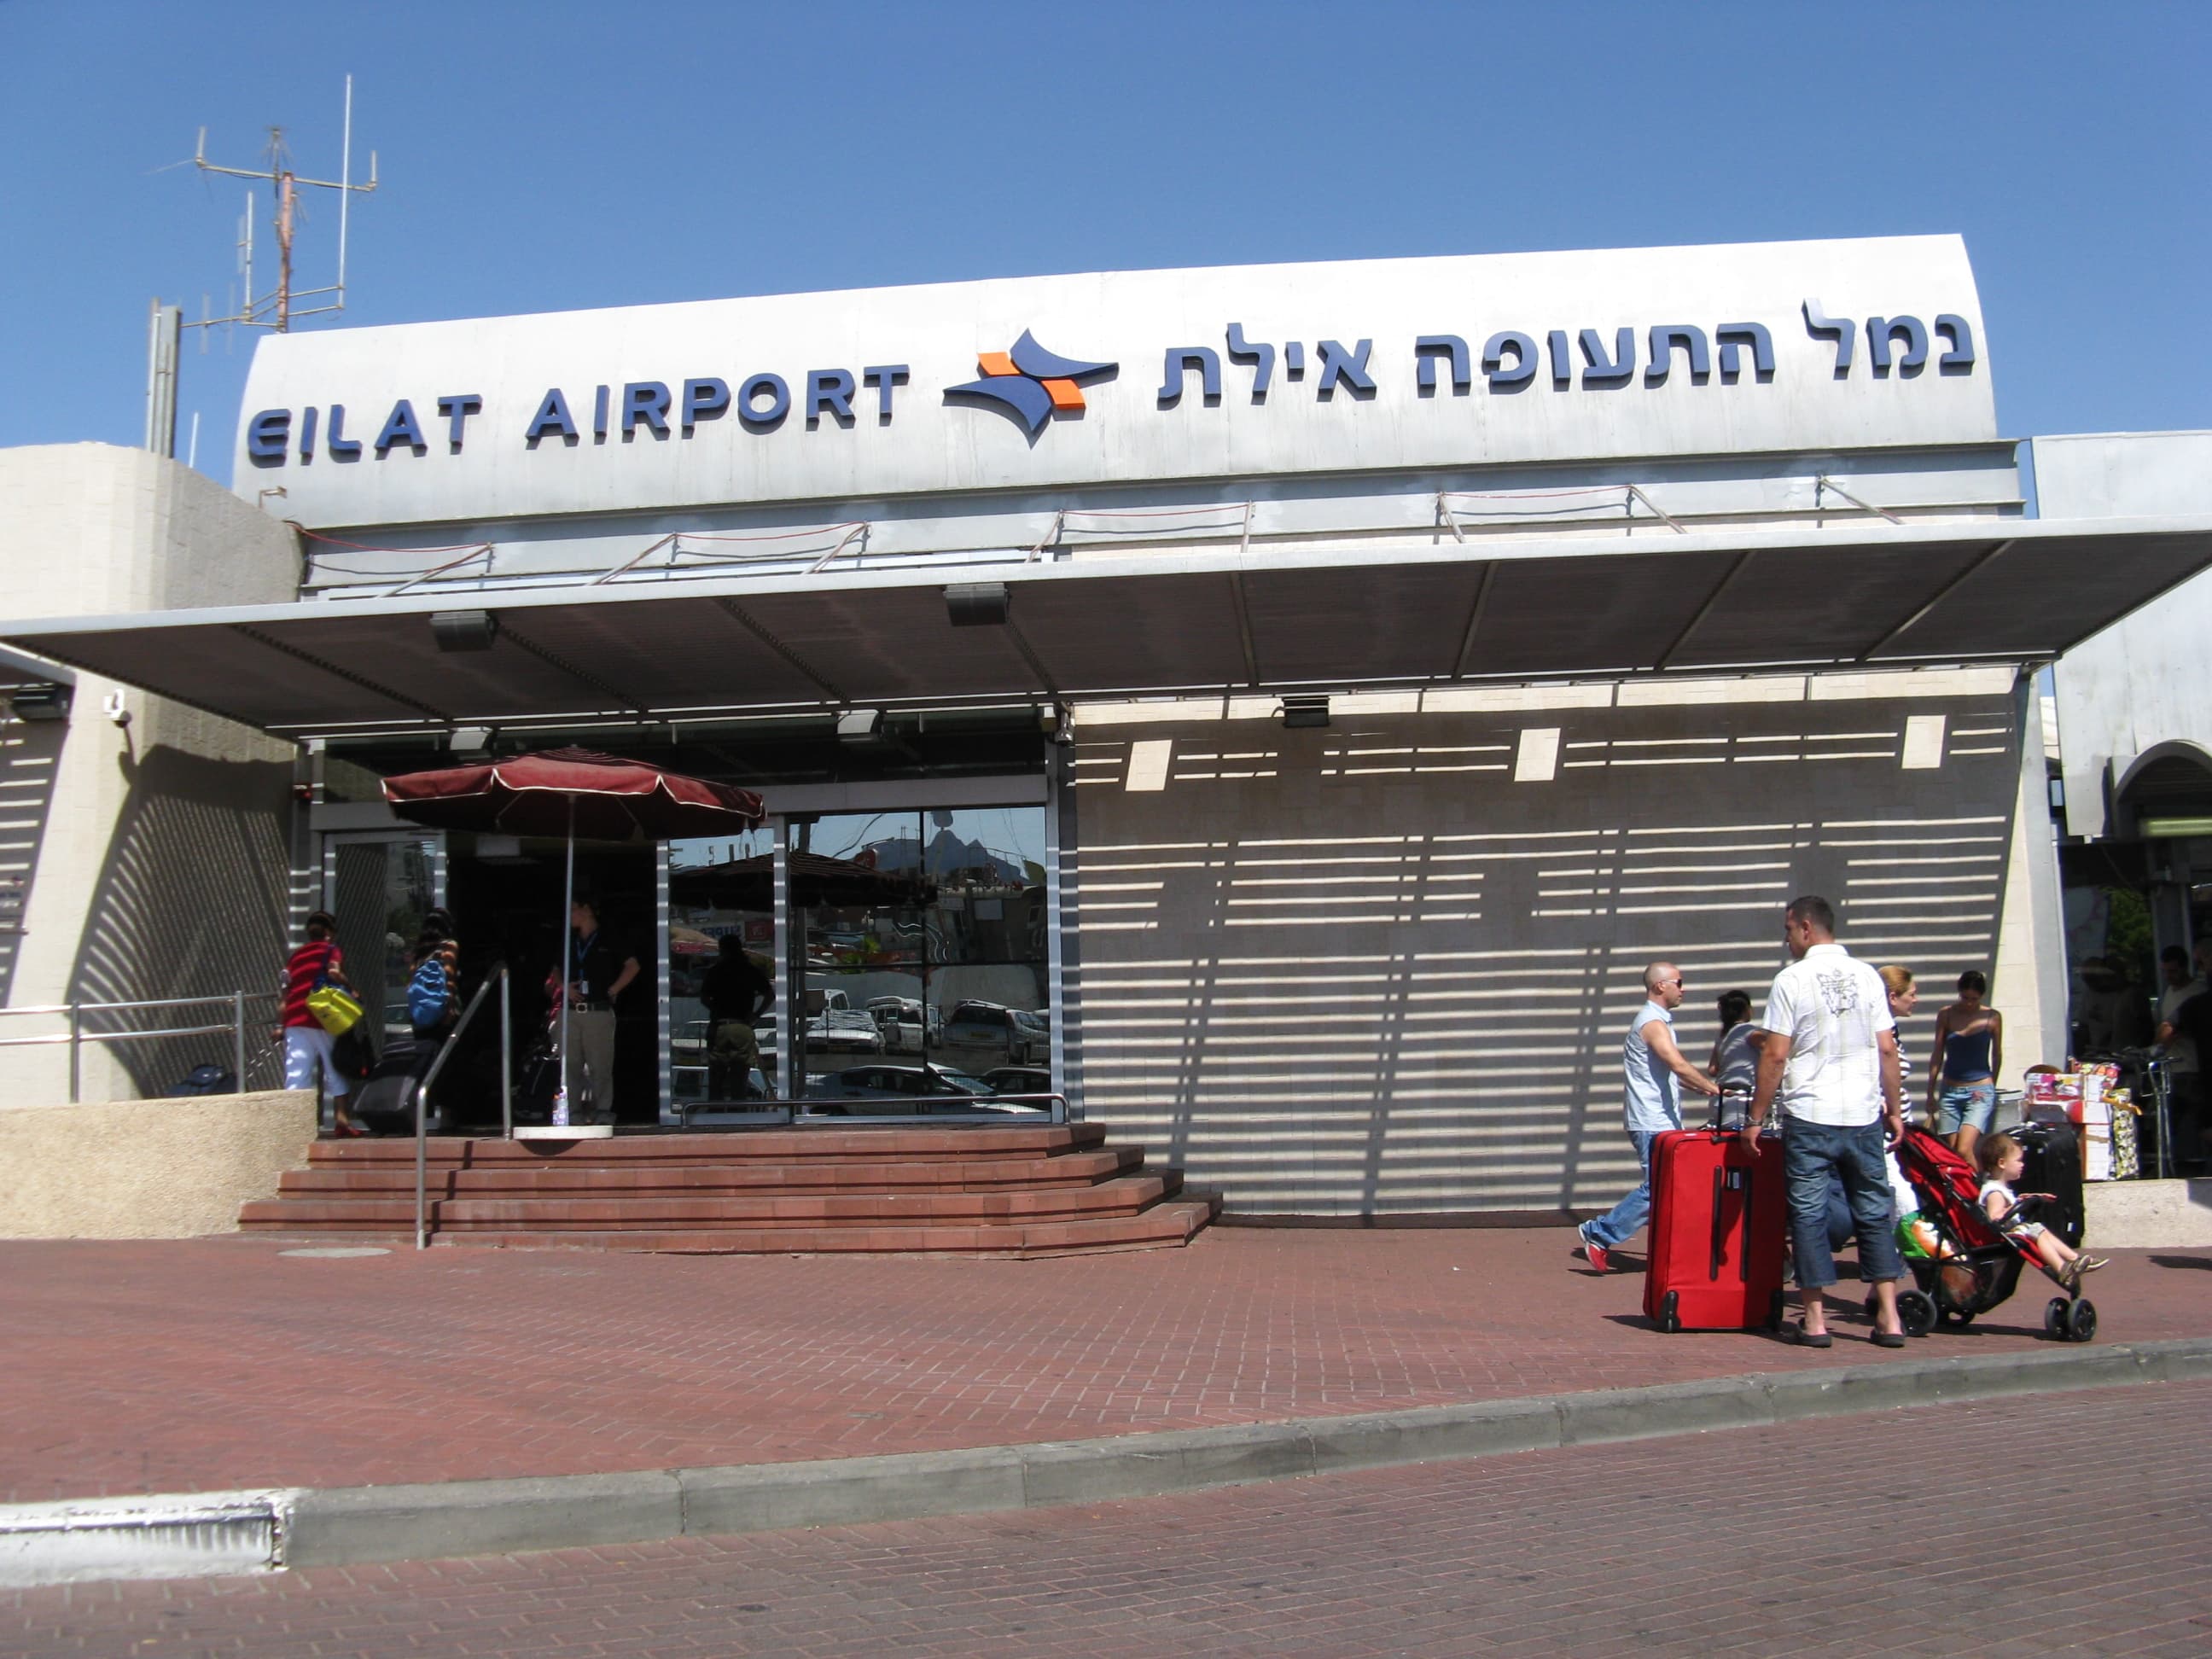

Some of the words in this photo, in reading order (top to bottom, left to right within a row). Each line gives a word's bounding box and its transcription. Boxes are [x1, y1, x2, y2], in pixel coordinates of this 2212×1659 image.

[1156, 323, 1377, 410] אילת
[1415, 322, 1776, 398] התעופה
[1802, 299, 1975, 378] נמל
[247, 394, 483, 467] EILAT
[524, 364, 910, 449] AIRPORT
